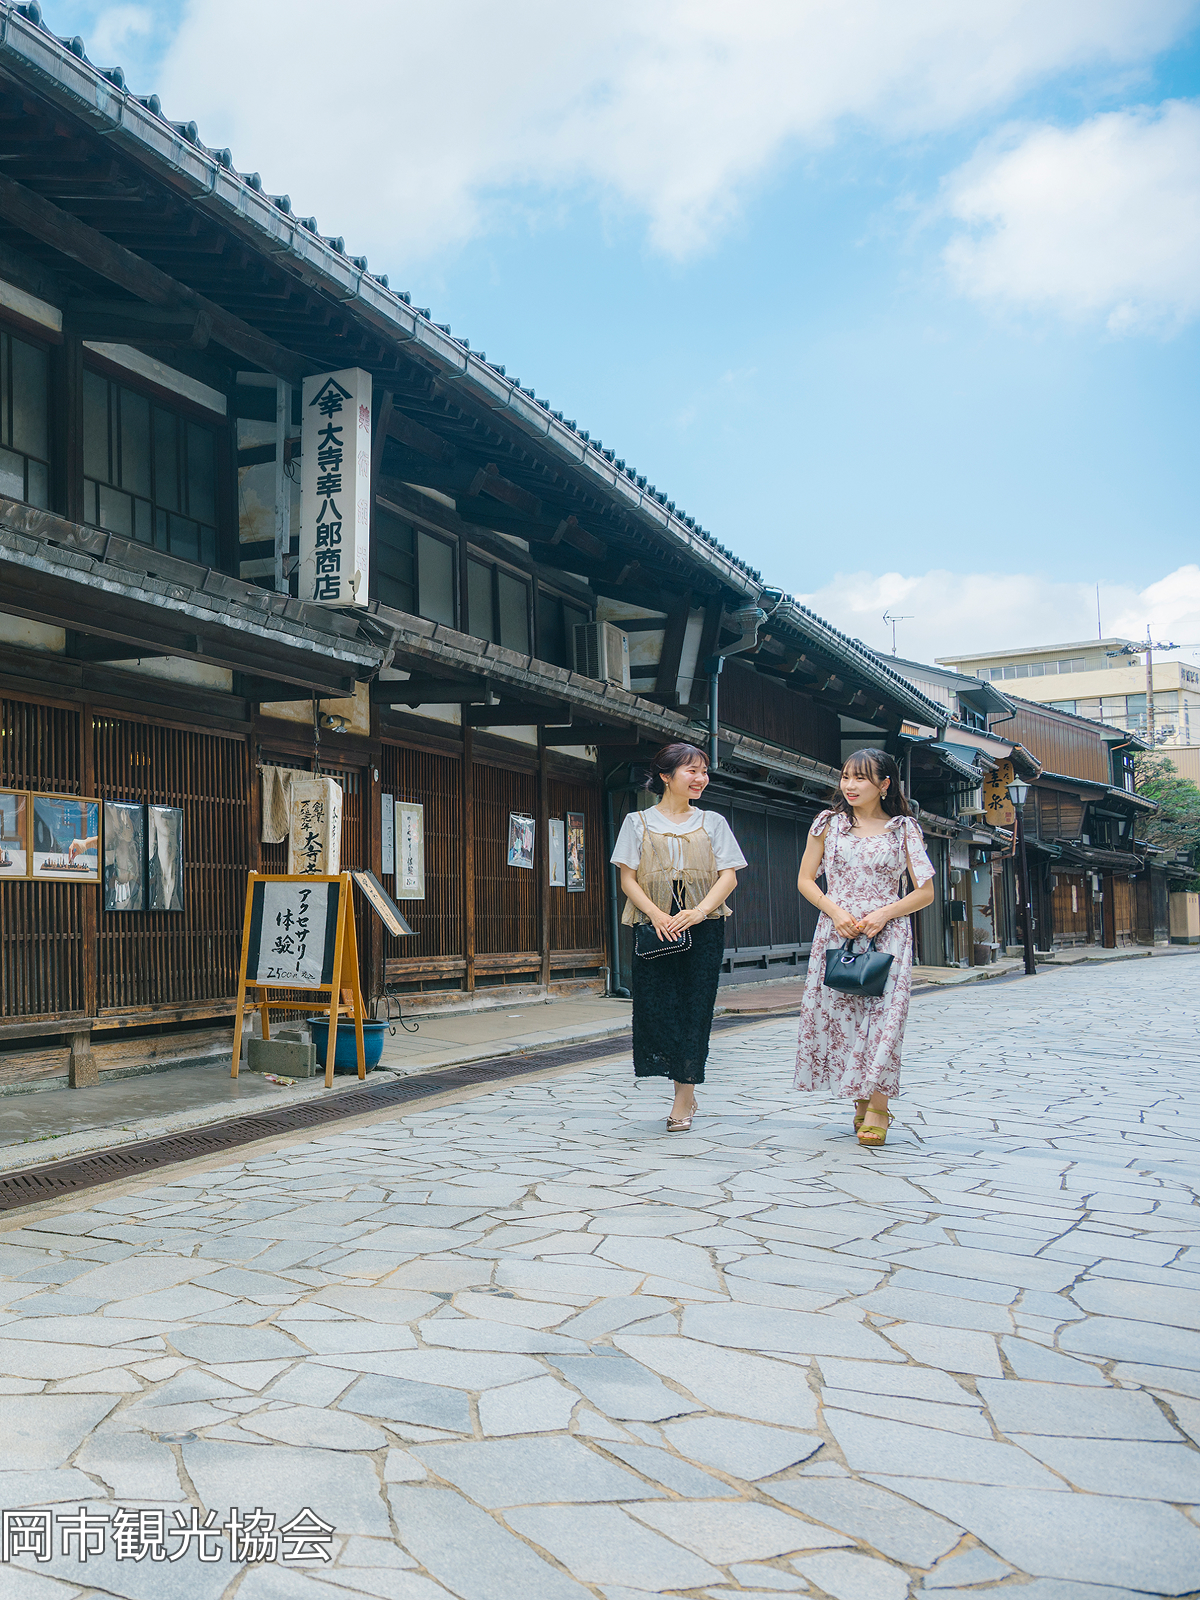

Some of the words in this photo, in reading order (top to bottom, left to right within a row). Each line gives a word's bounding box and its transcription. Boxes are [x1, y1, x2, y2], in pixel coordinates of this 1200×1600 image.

[313, 422, 344, 601] 大寺幸八郎商店
[271, 908, 295, 955] 体験
[295, 889, 312, 972] アクセサリー
